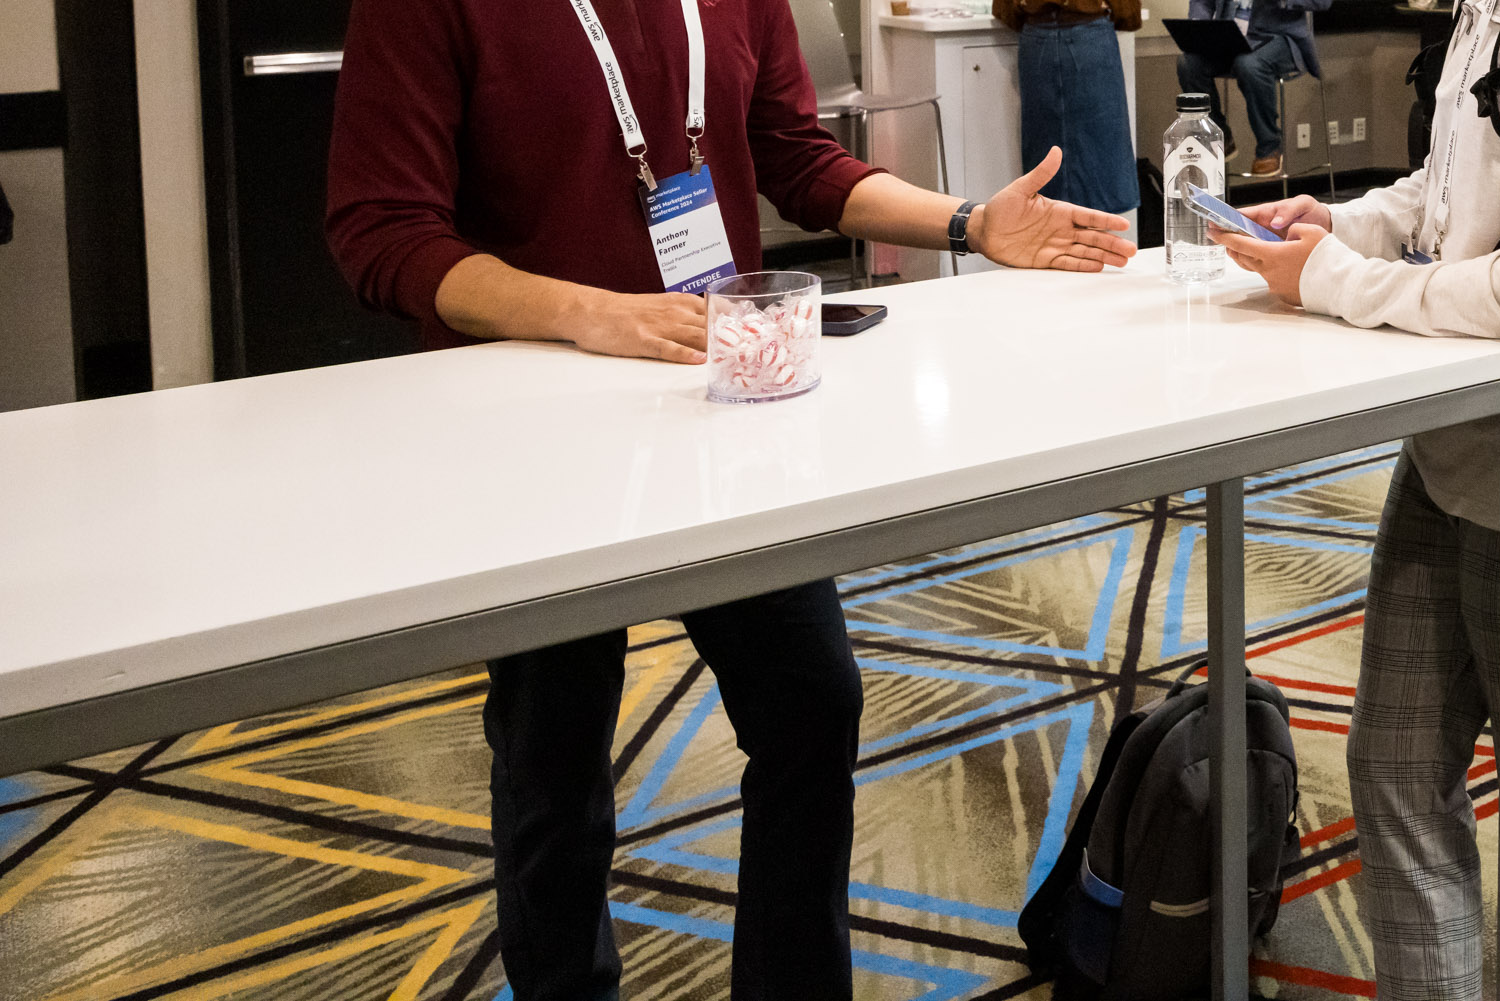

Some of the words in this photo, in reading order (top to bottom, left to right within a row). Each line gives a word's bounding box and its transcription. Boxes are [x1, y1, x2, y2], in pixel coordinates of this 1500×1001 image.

[587, 21, 603, 42] aws
[1460, 34, 1480, 89] marketplace
[605, 61, 628, 115] marketplace
[655, 186, 681, 198] marketplace
[649, 203, 662, 213] AWS
[662, 193, 693, 208] Marketplace
[651, 205, 680, 219] Conference
[680, 200, 693, 209] 2024
[656, 228, 689, 246] Anthony
[658, 241, 687, 256] Farmer
[682, 270, 722, 293] ATTENDEE
